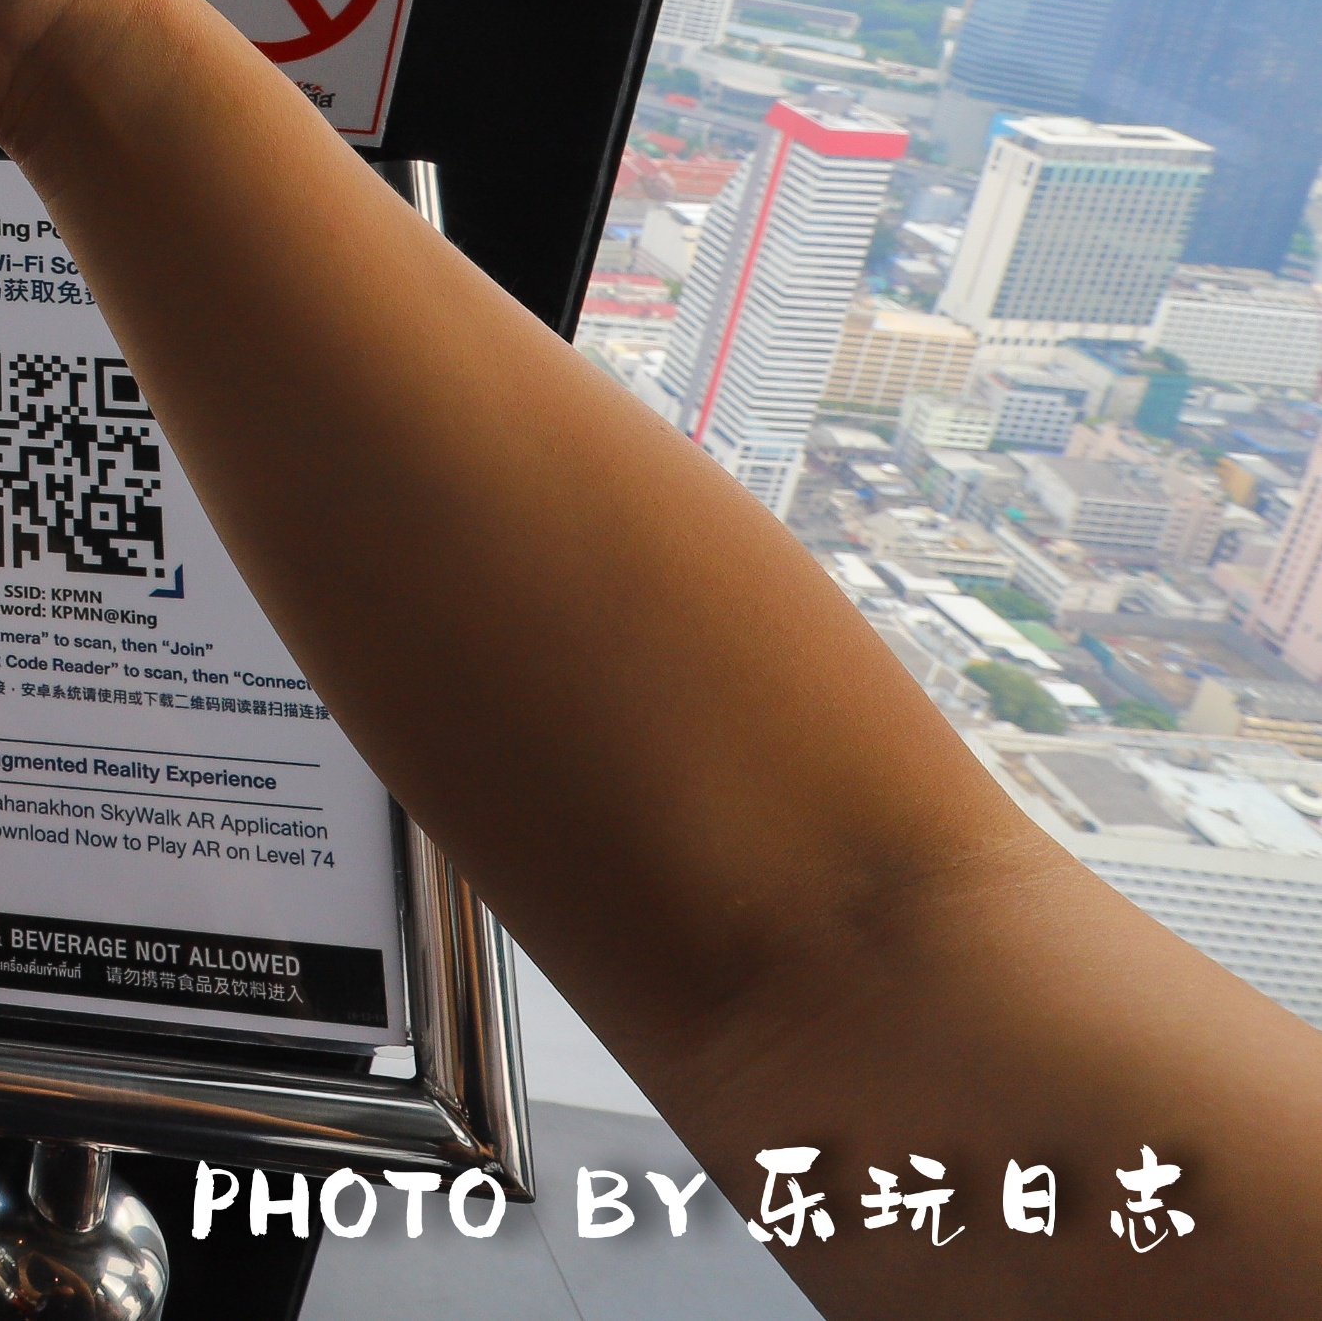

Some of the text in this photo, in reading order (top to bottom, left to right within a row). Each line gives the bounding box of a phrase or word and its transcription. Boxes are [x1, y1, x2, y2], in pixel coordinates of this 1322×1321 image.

[4, 584, 102, 604] SSID: KPMN
[51, 604, 157, 629] KPMN@King
[53, 633, 69, 647] to
[73, 637, 116, 653] scan,
[121, 637, 157, 653] then
[5, 654, 47, 670] Code
[123, 663, 139, 677] to
[144, 667, 187, 684] scan,
[191, 668, 228, 684] then
[93, 758, 160, 784] Reality
[166, 765, 276, 790] Experience
[100, 803, 181, 826] SkyWalk
[186, 811, 215, 829] AR
[220, 814, 327, 839] Application
[75, 828, 117, 848] Now
[122, 833, 141, 850] to
[147, 835, 187, 859] Play
[192, 839, 220, 858] AR
[226, 846, 249, 860] on
[256, 844, 304, 866] Level
[310, 849, 335, 868] 74
[11, 928, 126, 958] BEVERAGE
[135, 940, 180, 964] NOT
[189, 946, 299, 976] ALLOWED
[106, 965, 303, 1003] 请勿携带食品及饮料进入
